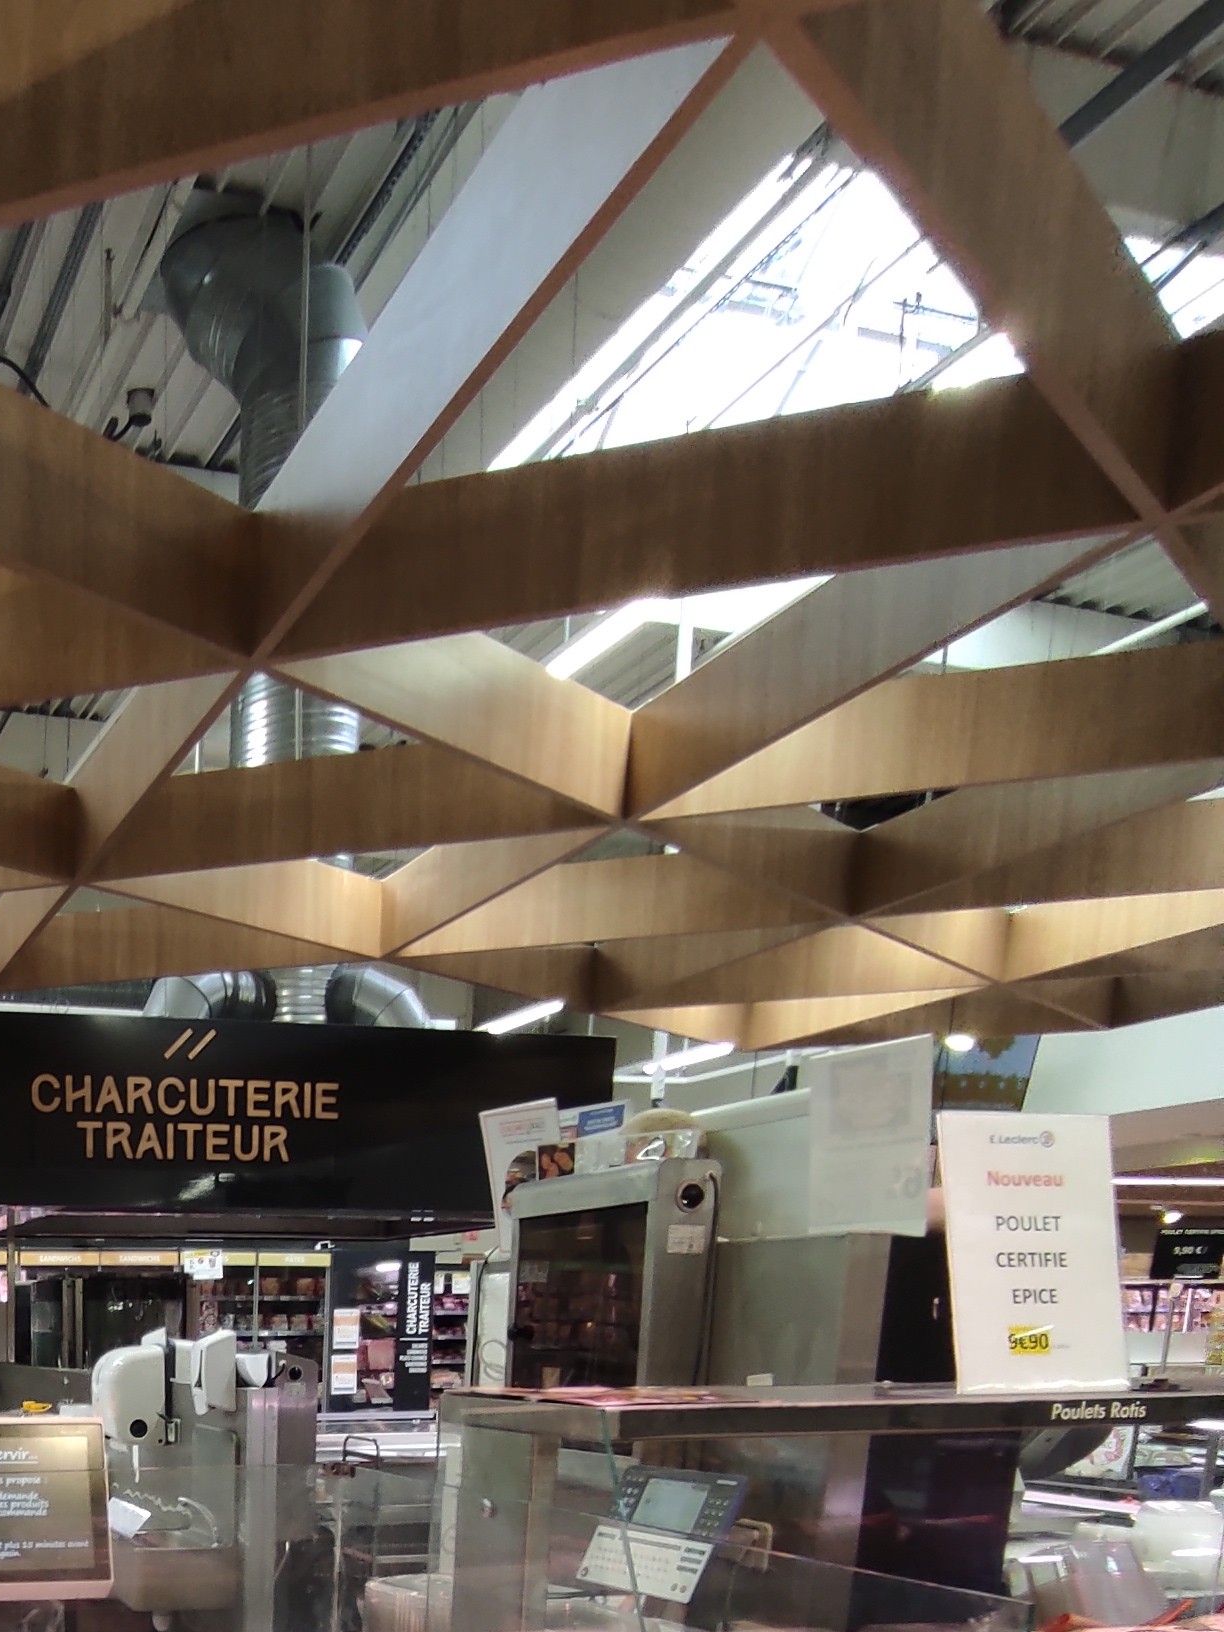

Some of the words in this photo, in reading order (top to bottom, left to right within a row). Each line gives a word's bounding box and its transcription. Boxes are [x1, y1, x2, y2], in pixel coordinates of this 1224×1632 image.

[31, 1073, 339, 1119] CHARCUTERIE
[76, 1121, 290, 1162] TRAITEUR
[987, 1171, 1064, 1187] Nouveau
[995, 1216, 1061, 1232] POULET
[996, 1252, 1068, 1268] CERTIFIE
[405, 1262, 420, 1335] CHARCUTERIE
[1012, 1288, 1058, 1304] EPICE
[418, 1282, 433, 1335] TRAITEUR
[1051, 1401, 1106, 1420] Poulets
